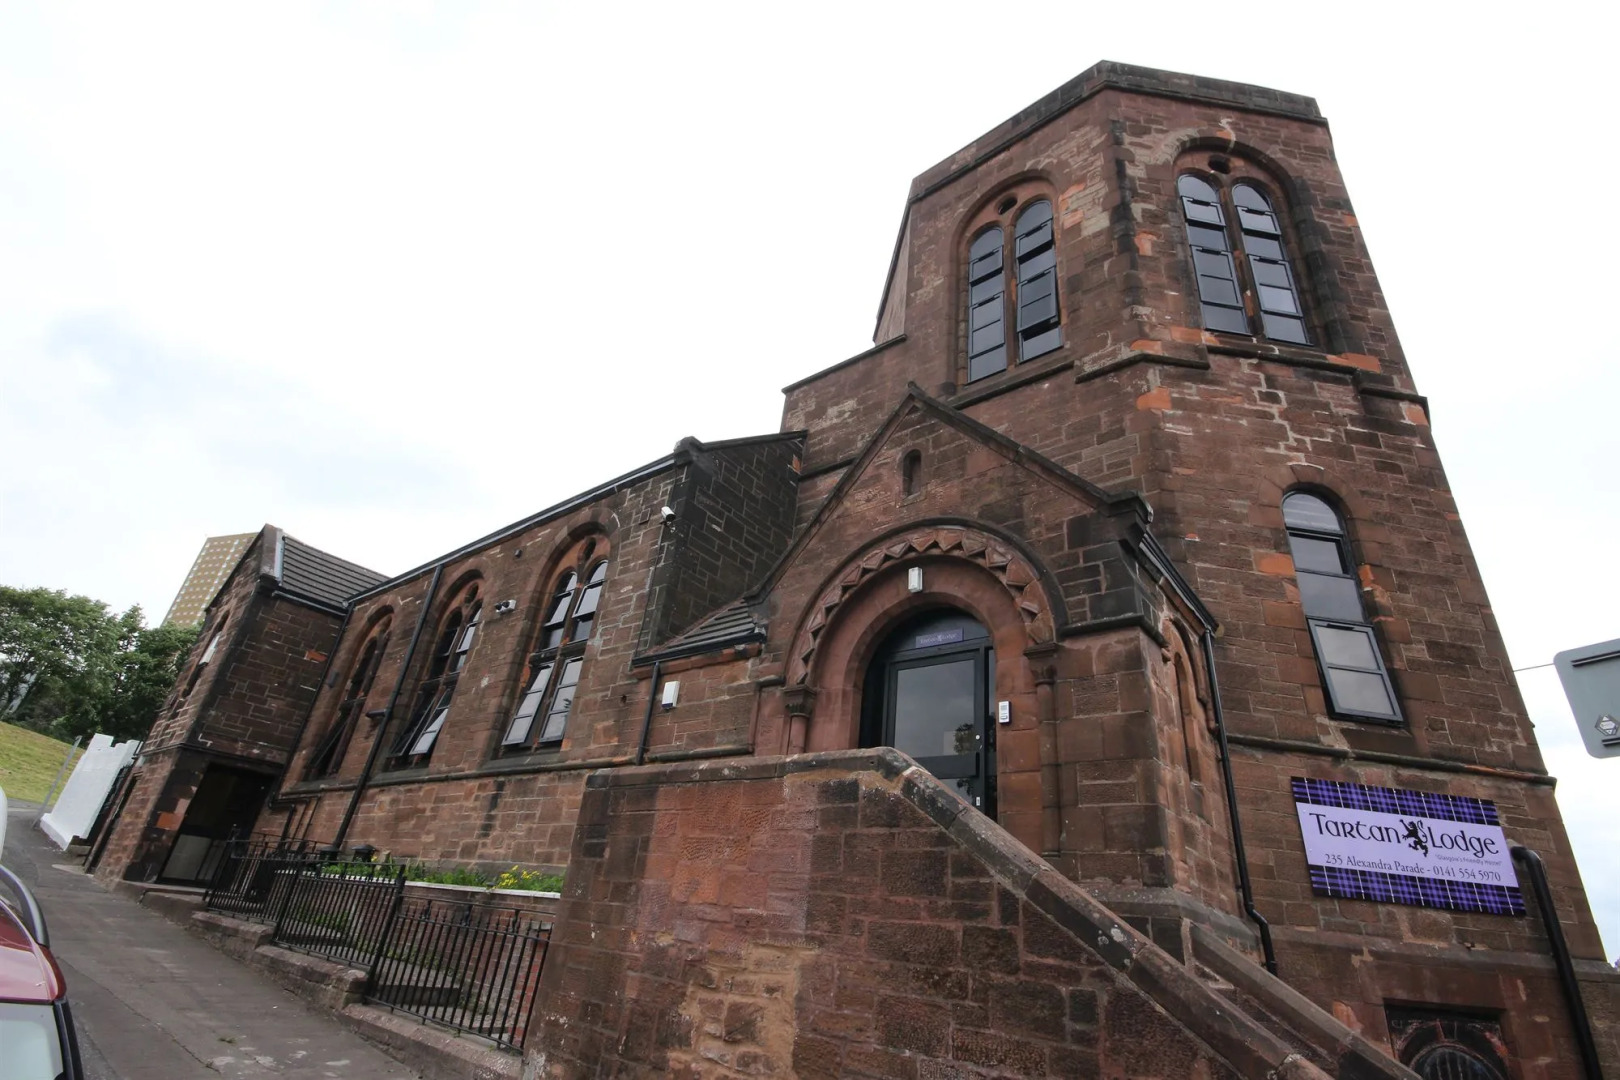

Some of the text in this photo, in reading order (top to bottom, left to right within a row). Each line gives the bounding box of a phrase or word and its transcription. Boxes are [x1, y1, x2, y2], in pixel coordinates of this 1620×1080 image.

[1427, 826, 1499, 859] Lodge
[1325, 853, 1343, 866] 235
[1346, 855, 1393, 871] Alexandra
[1394, 860, 1425, 874] Parade
[1432, 865, 1456, 877] 0141
[1458, 867, 1476, 880] 554
[1478, 870, 1502, 882] 5970
